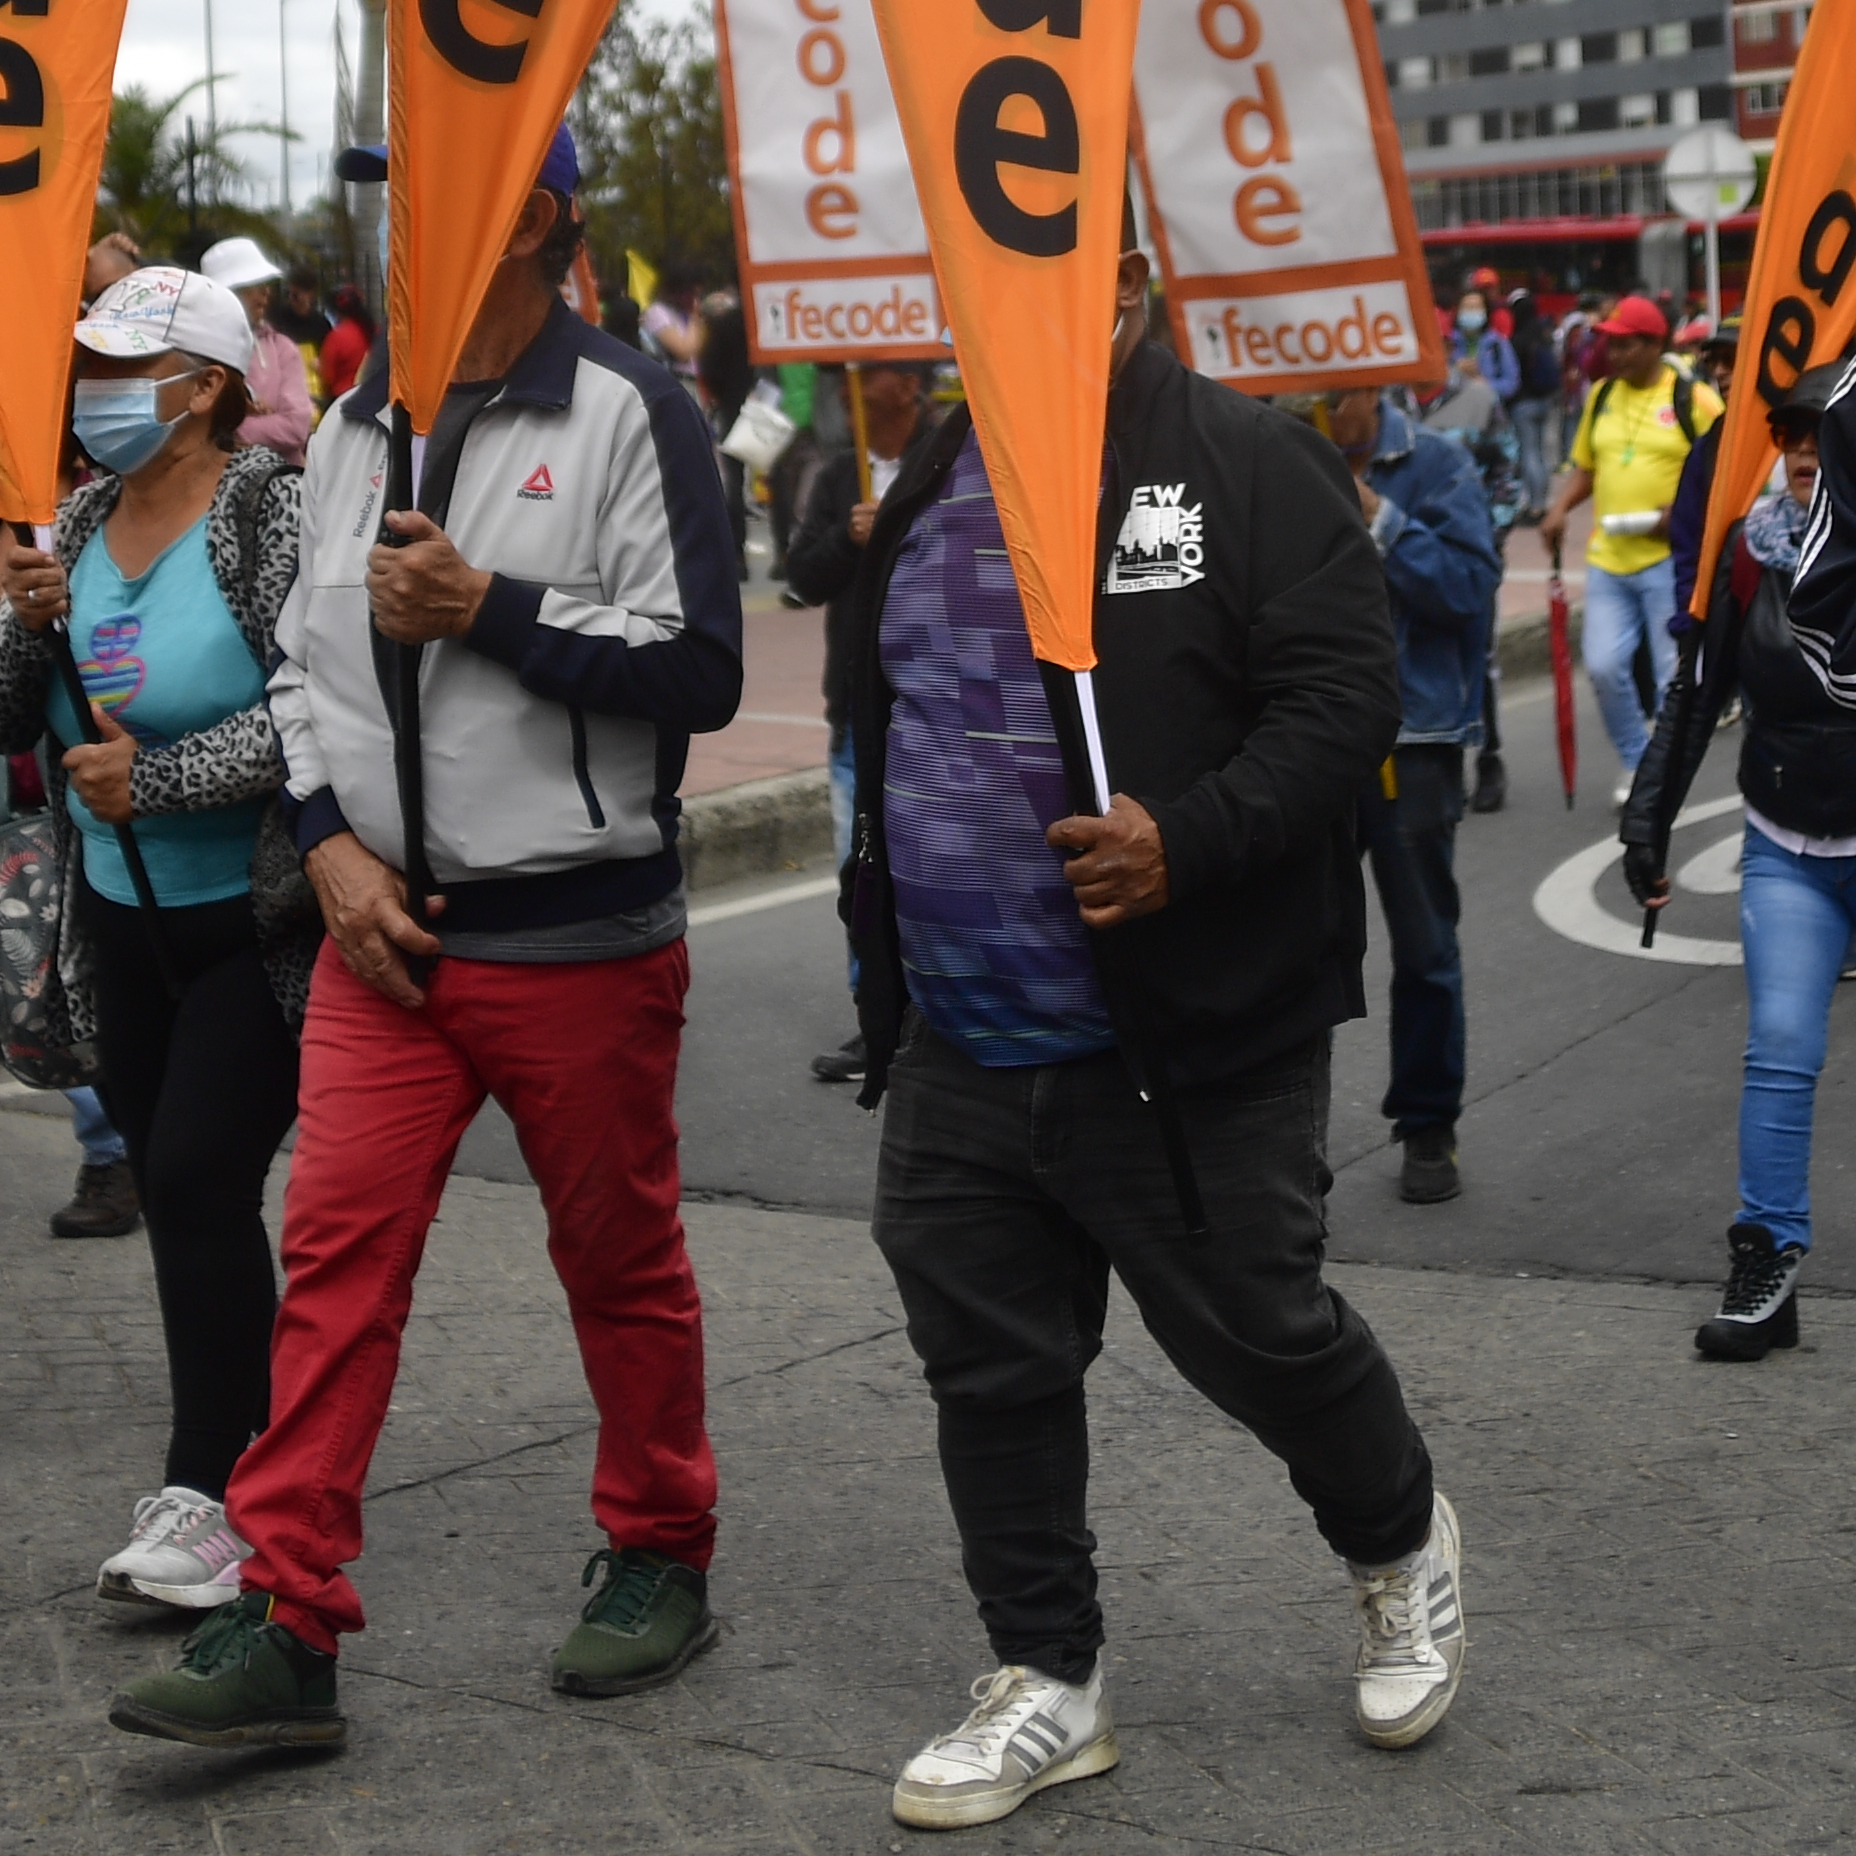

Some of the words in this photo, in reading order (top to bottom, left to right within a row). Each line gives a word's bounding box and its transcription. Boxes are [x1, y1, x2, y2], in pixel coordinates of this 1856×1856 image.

[785, 283, 930, 341] fecode
[1220, 294, 1404, 370] fecode
[352, 490, 377, 538] Reebok
[515, 489, 554, 501] Reebok
[1178, 501, 1206, 587] YORK
[1114, 577, 1169, 592] DISTRICTS
